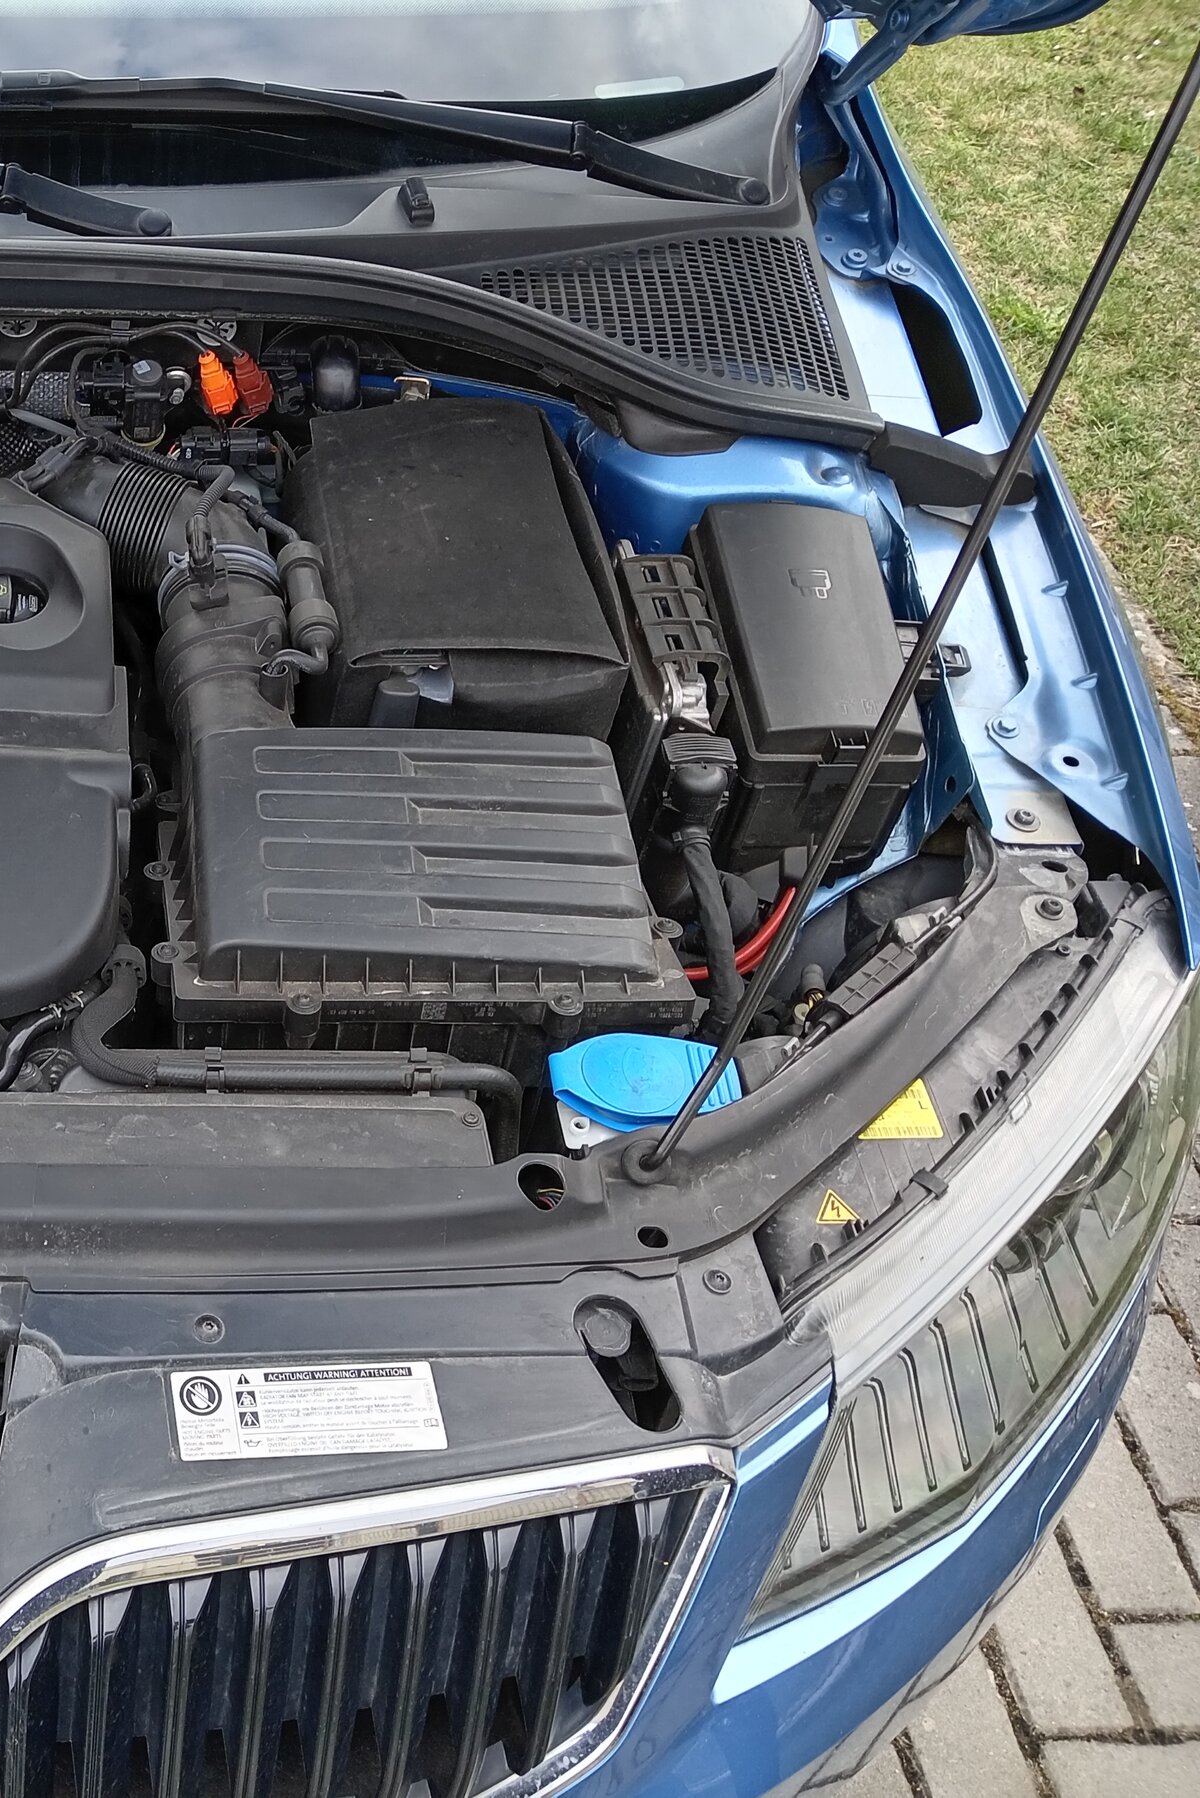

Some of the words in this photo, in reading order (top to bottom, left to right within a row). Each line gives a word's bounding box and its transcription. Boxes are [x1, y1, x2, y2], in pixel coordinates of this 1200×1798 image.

[267, 1372, 312, 1382] ACHTUNG!
[313, 1370, 358, 1380] WARNING!
[359, 1367, 409, 1378] ATTENTION!
